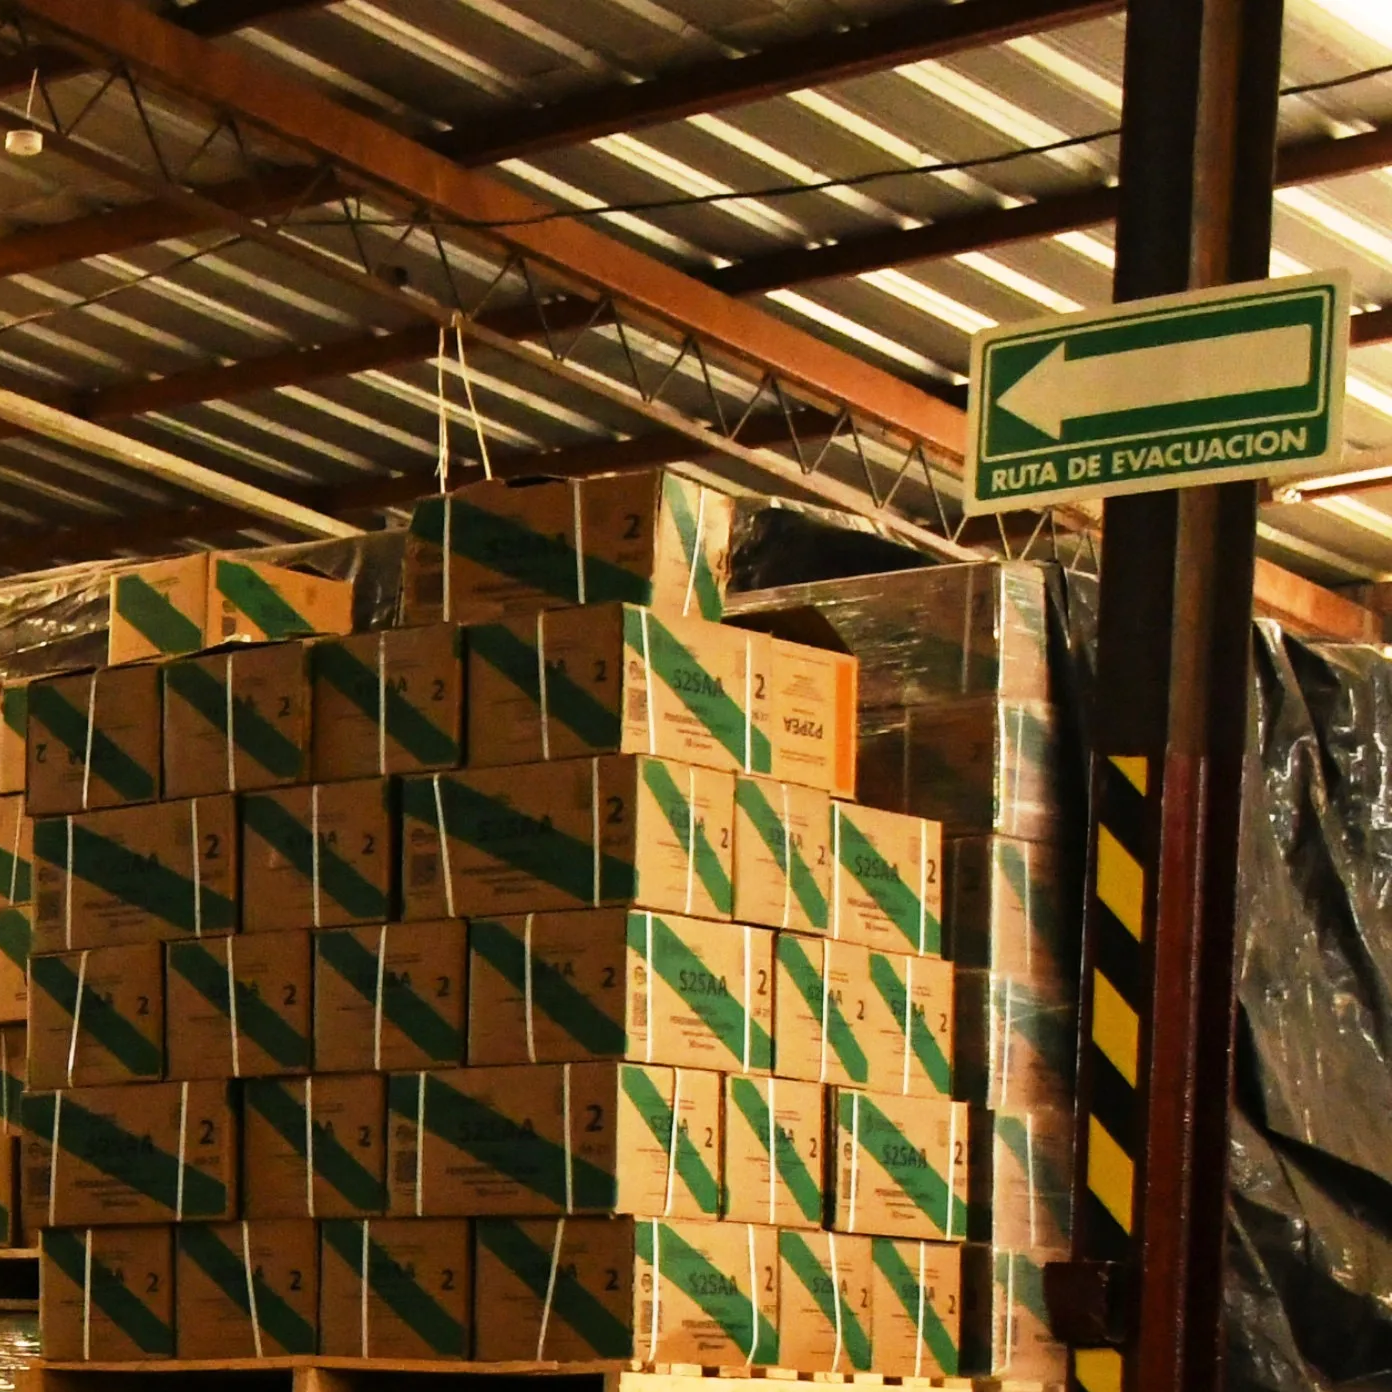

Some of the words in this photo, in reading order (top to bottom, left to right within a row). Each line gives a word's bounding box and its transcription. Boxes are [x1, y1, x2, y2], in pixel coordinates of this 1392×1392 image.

[991, 461, 1058, 492] RUTA
[1068, 453, 1100, 480] DE
[1112, 427, 1307, 474] EVACUACION
[623, 514, 639, 538] 2
[594, 660, 607, 681] 2
[433, 680, 444, 700] 2
[755, 674, 765, 699] 2
[277, 697, 290, 717] 2
[605, 797, 623, 822] 2
[205, 835, 219, 859] 2
[362, 835, 374, 854] 2
[721, 828, 728, 849] 2
[817, 845, 826, 866] 2
[927, 859, 936, 884] 2
[436, 977, 449, 997] 2
[602, 967, 615, 987] 2
[758, 970, 767, 995] 2
[137, 996, 149, 1014] 2
[283, 985, 296, 1005] 2
[857, 1001, 865, 1020] 2
[940, 1014, 948, 1032] 2
[586, 1105, 602, 1130] 2
[200, 1121, 214, 1144] 2
[359, 1126, 371, 1146] 2
[705, 1128, 713, 1148] 2
[810, 1138, 817, 1158] 2
[954, 1141, 963, 1164] 2
[147, 1273, 159, 1293] 2
[289, 1272, 302, 1291] 2
[441, 1271, 454, 1290] 2
[605, 1270, 617, 1291] 2
[765, 1267, 773, 1291] 2
[861, 1289, 868, 1308] 2
[948, 1294, 955, 1314] 2
